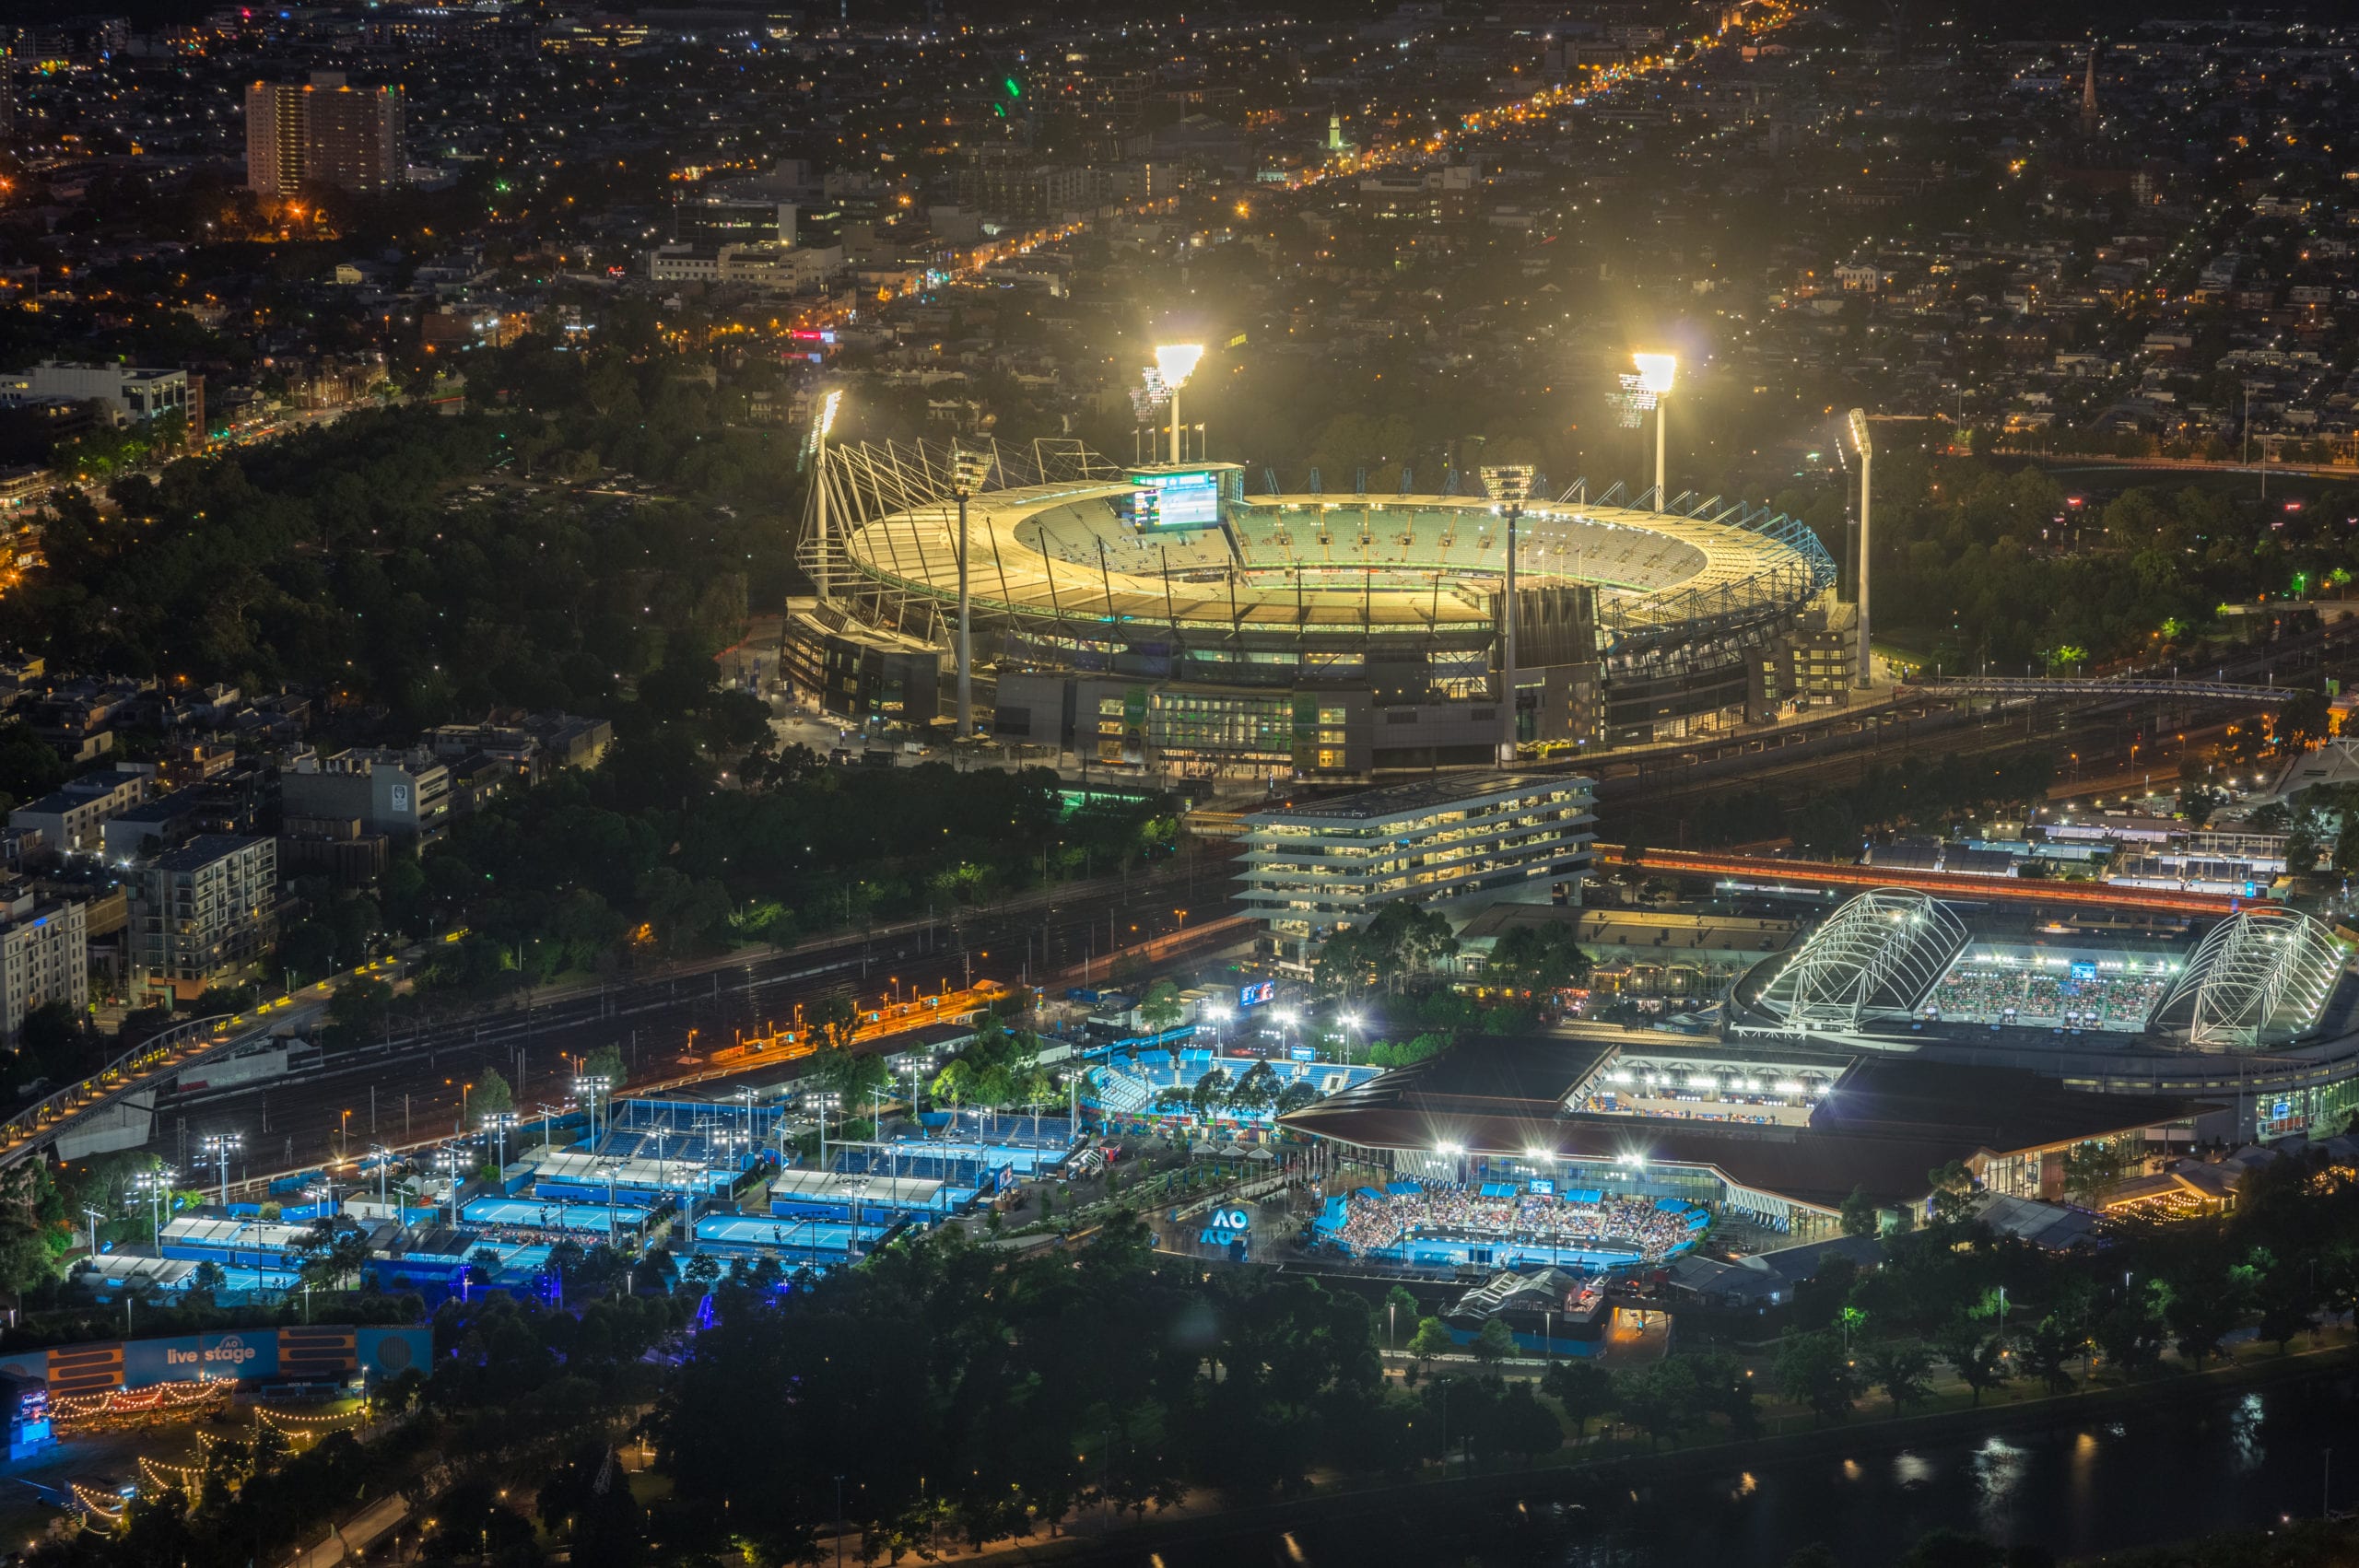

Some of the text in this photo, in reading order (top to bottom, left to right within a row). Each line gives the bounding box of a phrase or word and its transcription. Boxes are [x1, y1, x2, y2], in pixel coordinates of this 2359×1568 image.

[1213, 1209, 1247, 1229] AO
[167, 1346, 255, 1363] live stage
